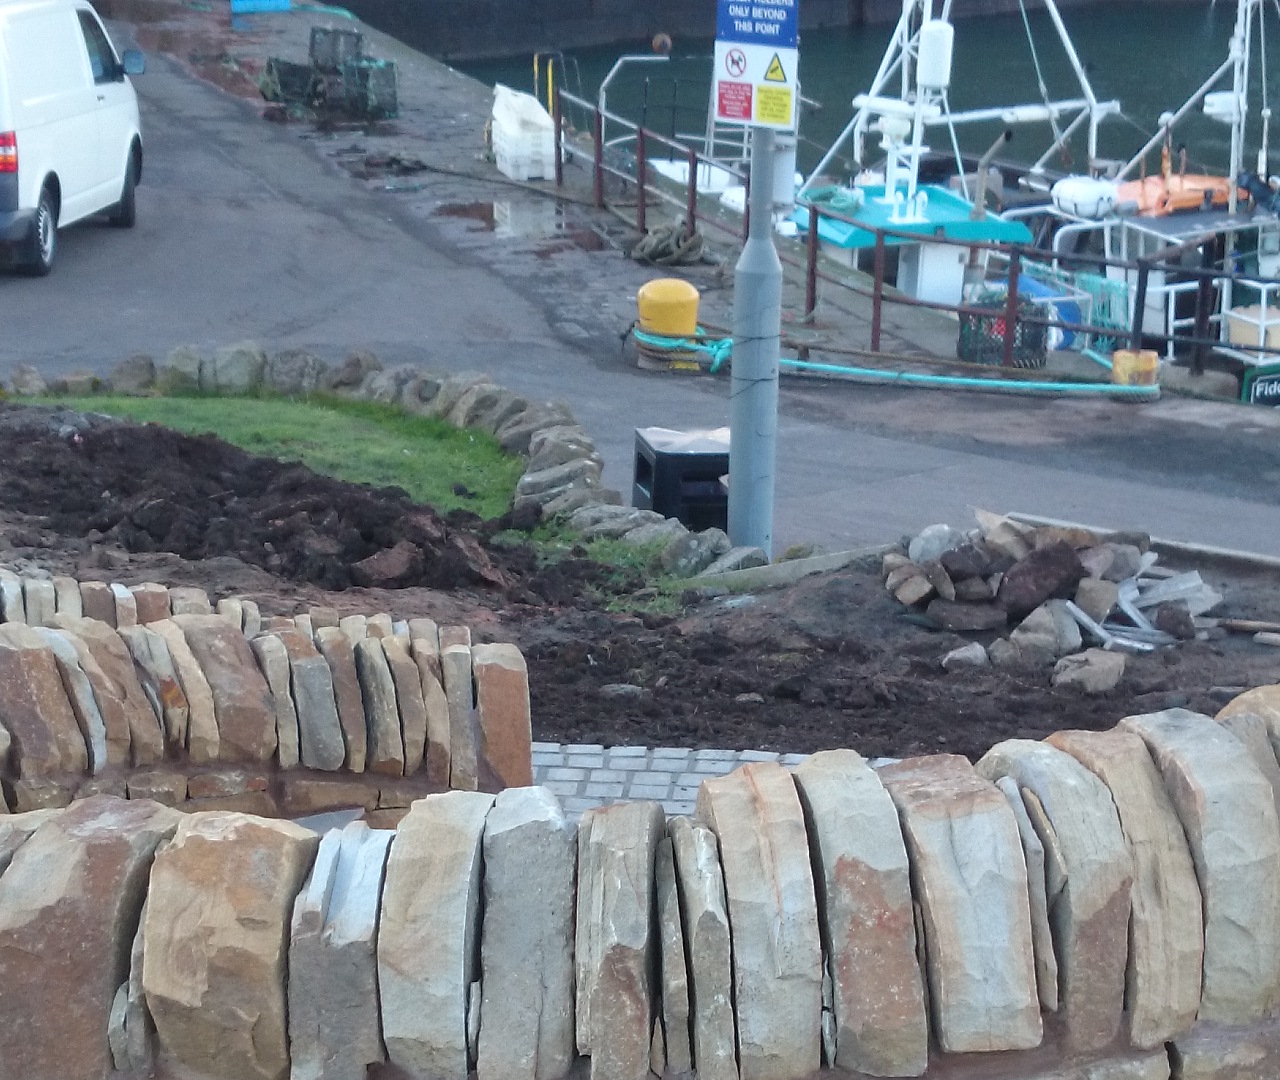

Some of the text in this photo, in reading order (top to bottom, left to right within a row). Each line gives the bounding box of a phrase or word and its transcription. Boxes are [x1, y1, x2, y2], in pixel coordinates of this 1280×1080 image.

[729, 4, 786, 20] ONLY BEYOND
[734, 20, 780, 35] THIS POINT
